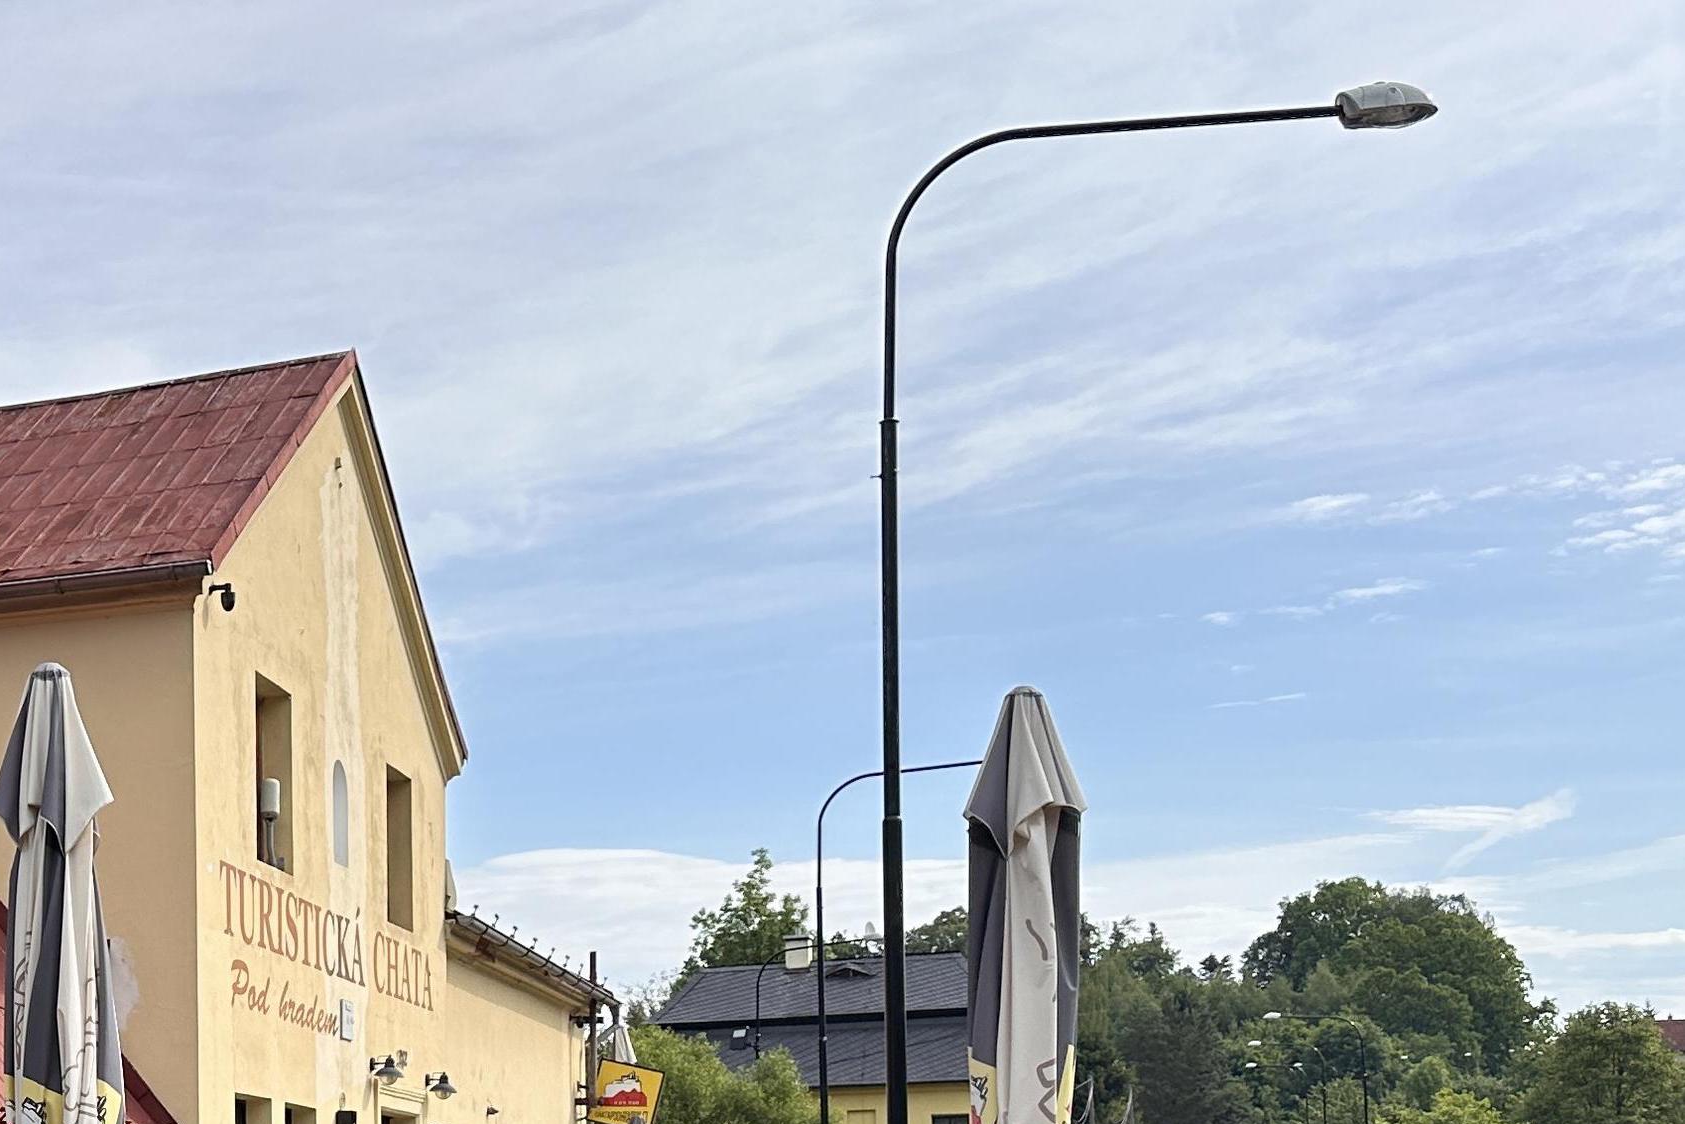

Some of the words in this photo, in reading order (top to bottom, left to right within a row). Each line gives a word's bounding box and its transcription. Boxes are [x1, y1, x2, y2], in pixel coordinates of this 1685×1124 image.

[219, 861, 366, 988] TURISTICKÁ
[374, 930, 434, 1012] CHATA
[230, 958, 271, 1016] Pod
[278, 979, 339, 1037] hradem
